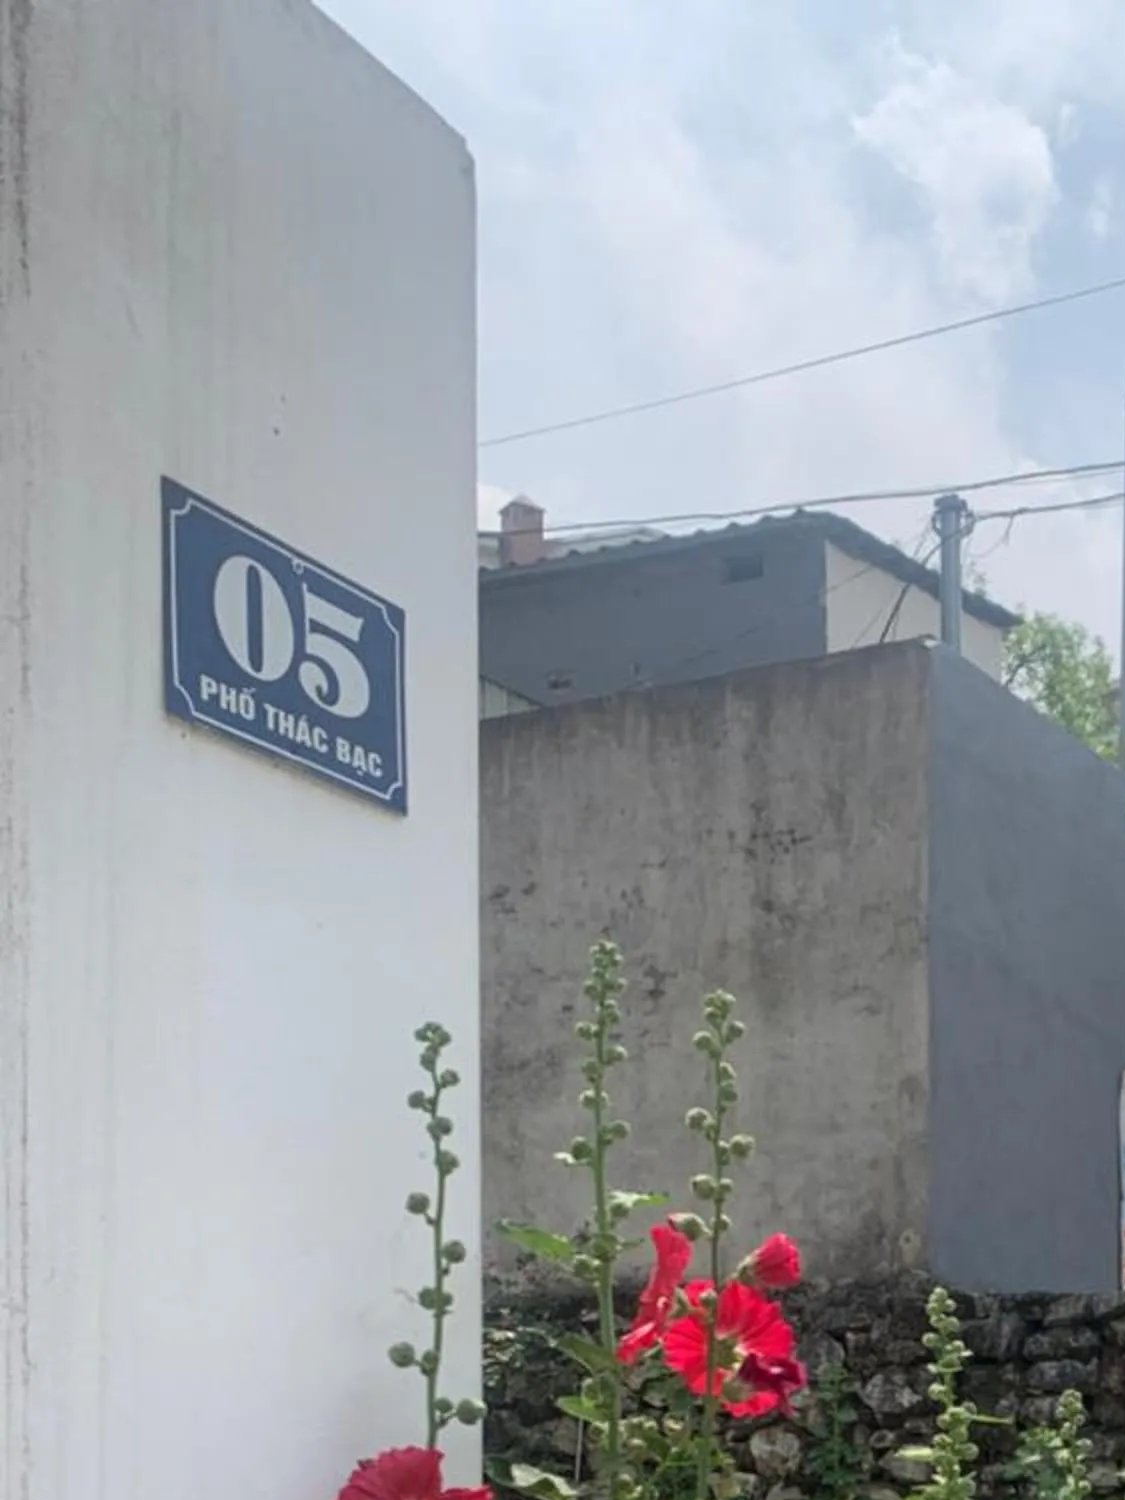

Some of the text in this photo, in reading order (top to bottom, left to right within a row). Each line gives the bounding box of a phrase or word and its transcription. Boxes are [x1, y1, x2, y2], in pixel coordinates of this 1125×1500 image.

[213, 555, 370, 719] 05
[199, 673, 383, 777] PHỐ THÁC BẠC
